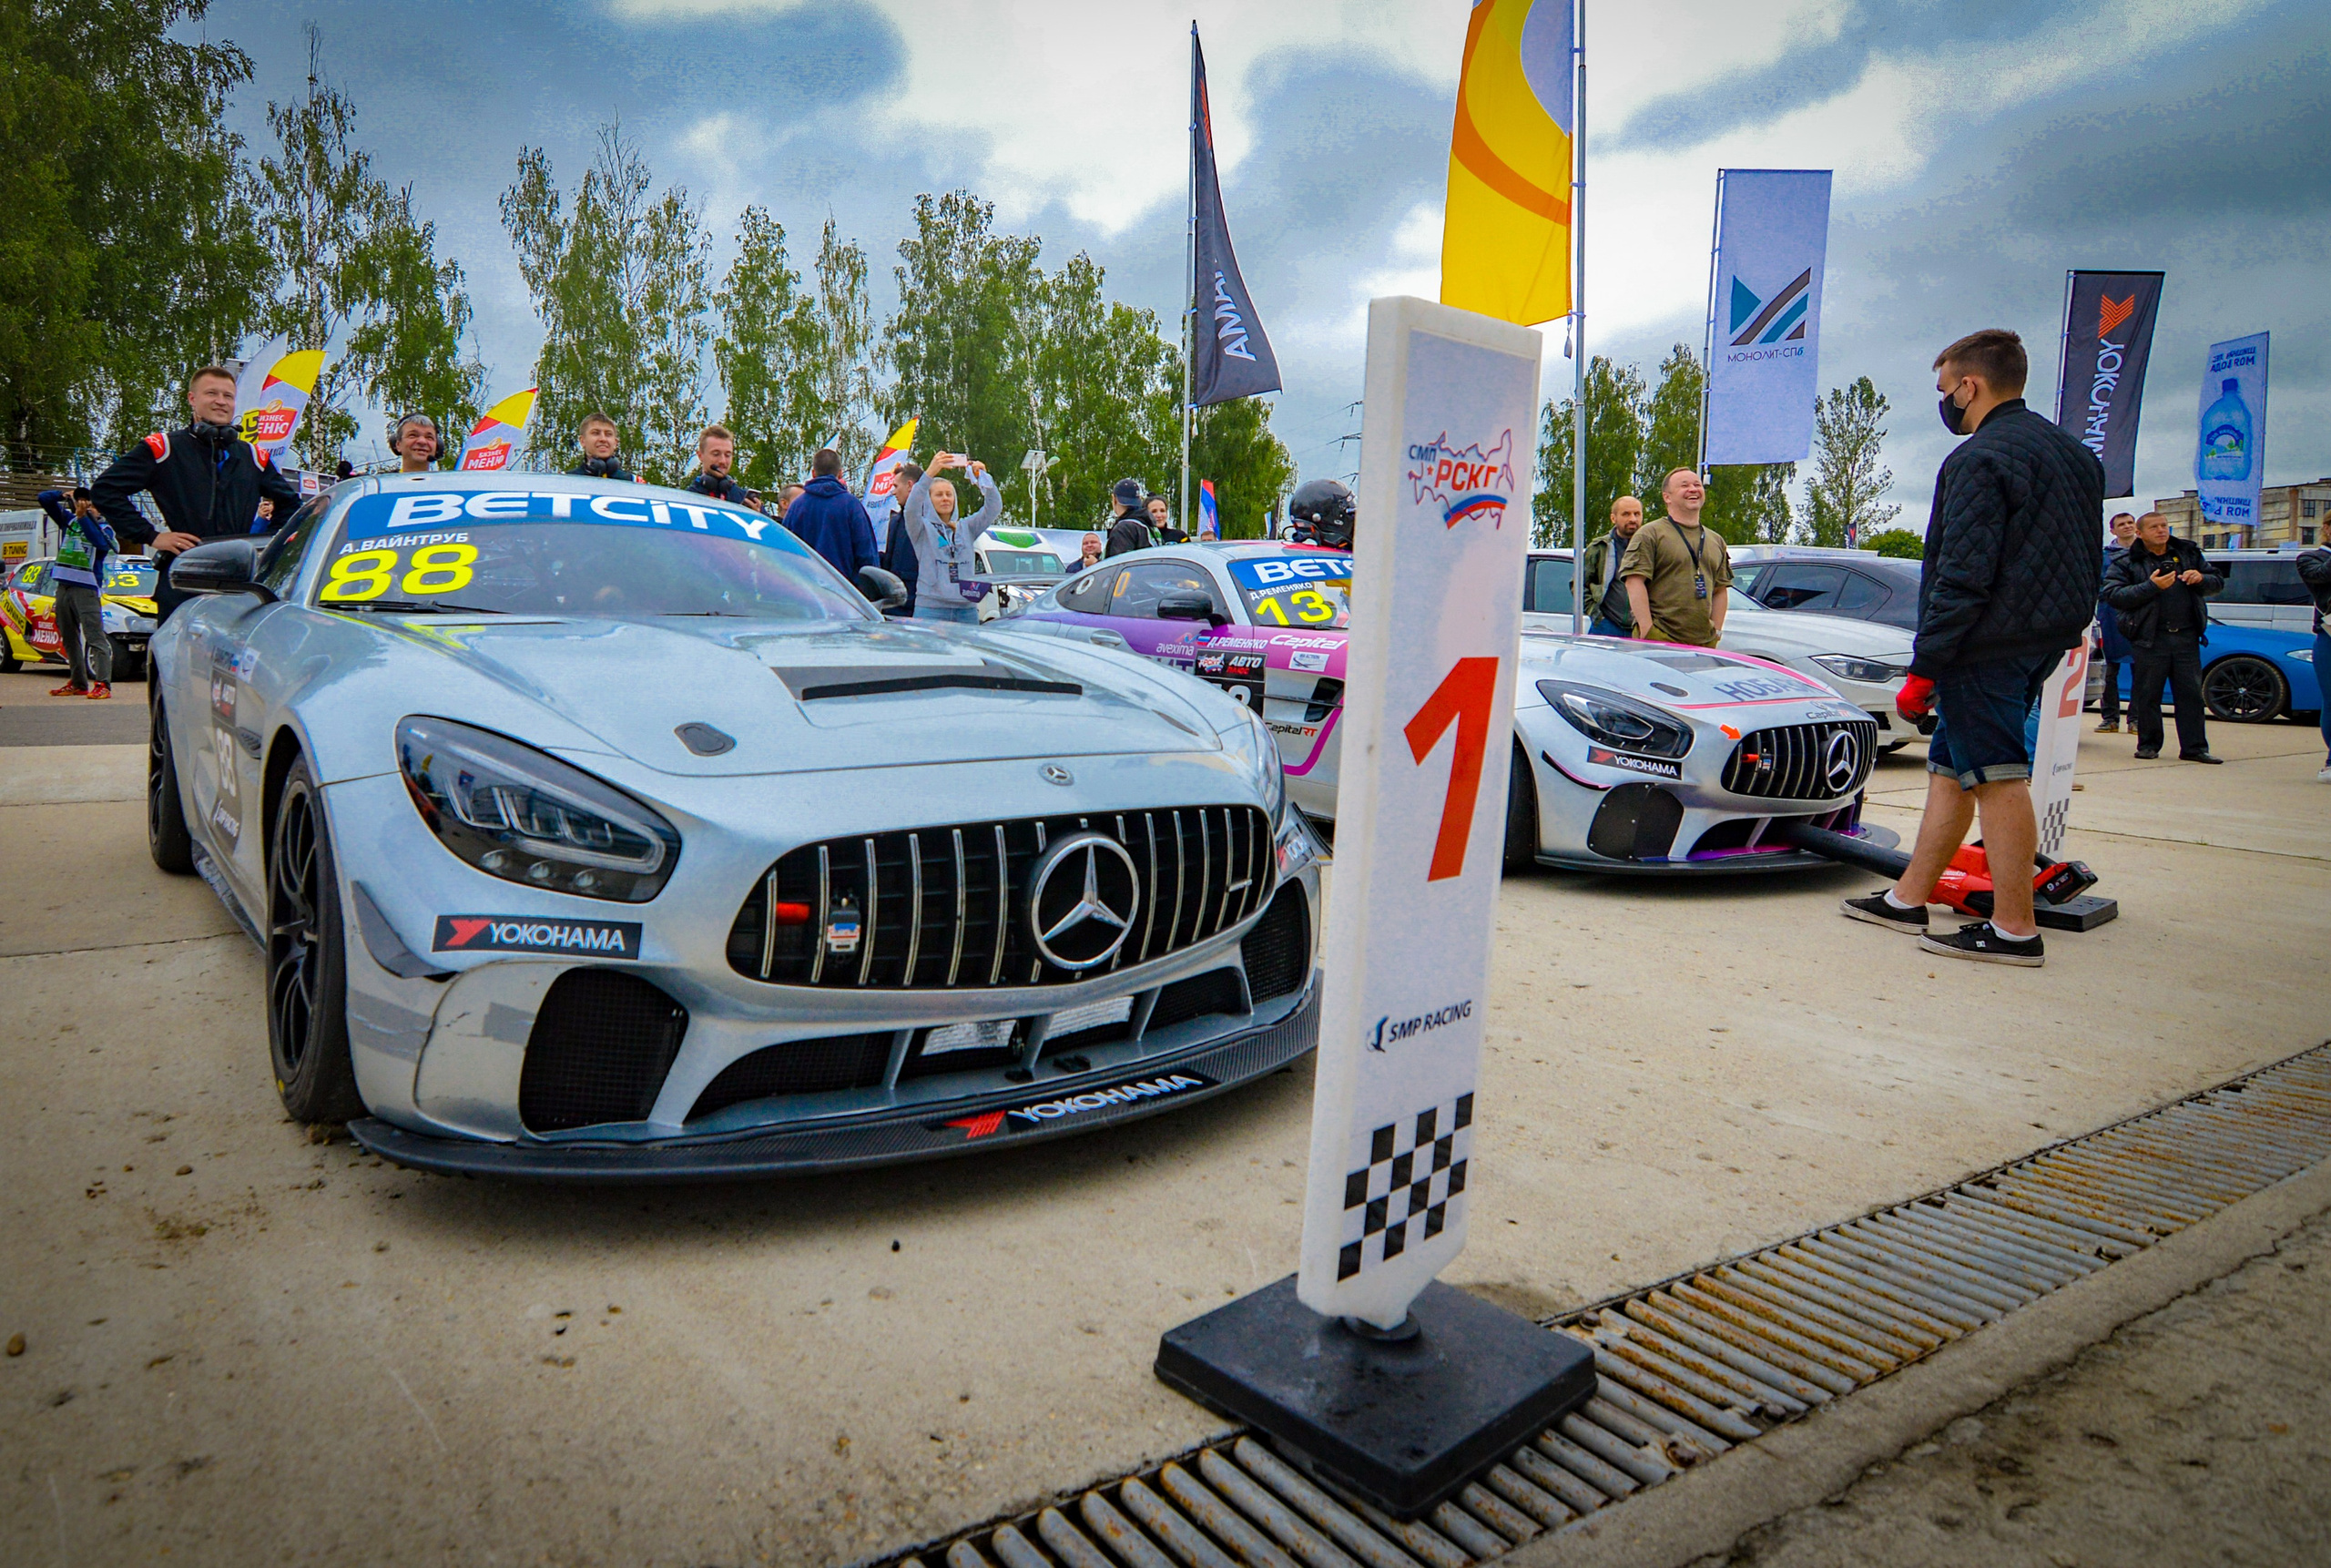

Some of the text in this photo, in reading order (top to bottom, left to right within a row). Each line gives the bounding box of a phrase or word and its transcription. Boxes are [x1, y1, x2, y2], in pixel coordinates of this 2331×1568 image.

[257, 422, 290, 434] ЕНЮ
[467, 455, 504, 470] МЕНЮ
[1409, 444, 1437, 463] СМП
[1434, 459, 1498, 491] РСКГ
[338, 532, 469, 555] А.ВАЙНТРУБ
[22, 565, 42, 583] 83
[320, 544, 478, 601] 88
[1250, 582, 1313, 601] Д.РЕМЕНЯКО
[1256, 590, 1334, 626] 13
[33, 629, 59, 645] МЕНЮ
[1206, 636, 1268, 650] Д.РЕМЕНЯКО
[1269, 634, 1348, 649] Capital
[1155, 642, 1194, 656] avexima
[1228, 656, 1263, 668] АВТО
[2058, 636, 2088, 718] 2
[1403, 657, 1499, 883] 1
[1613, 754, 1677, 776] YOKOHAMA
[488, 921, 626, 952] YOKOHAMA
[1389, 999, 1472, 1043] SMP RACING
[1008, 1074, 1204, 1123] YOKOHAMA
